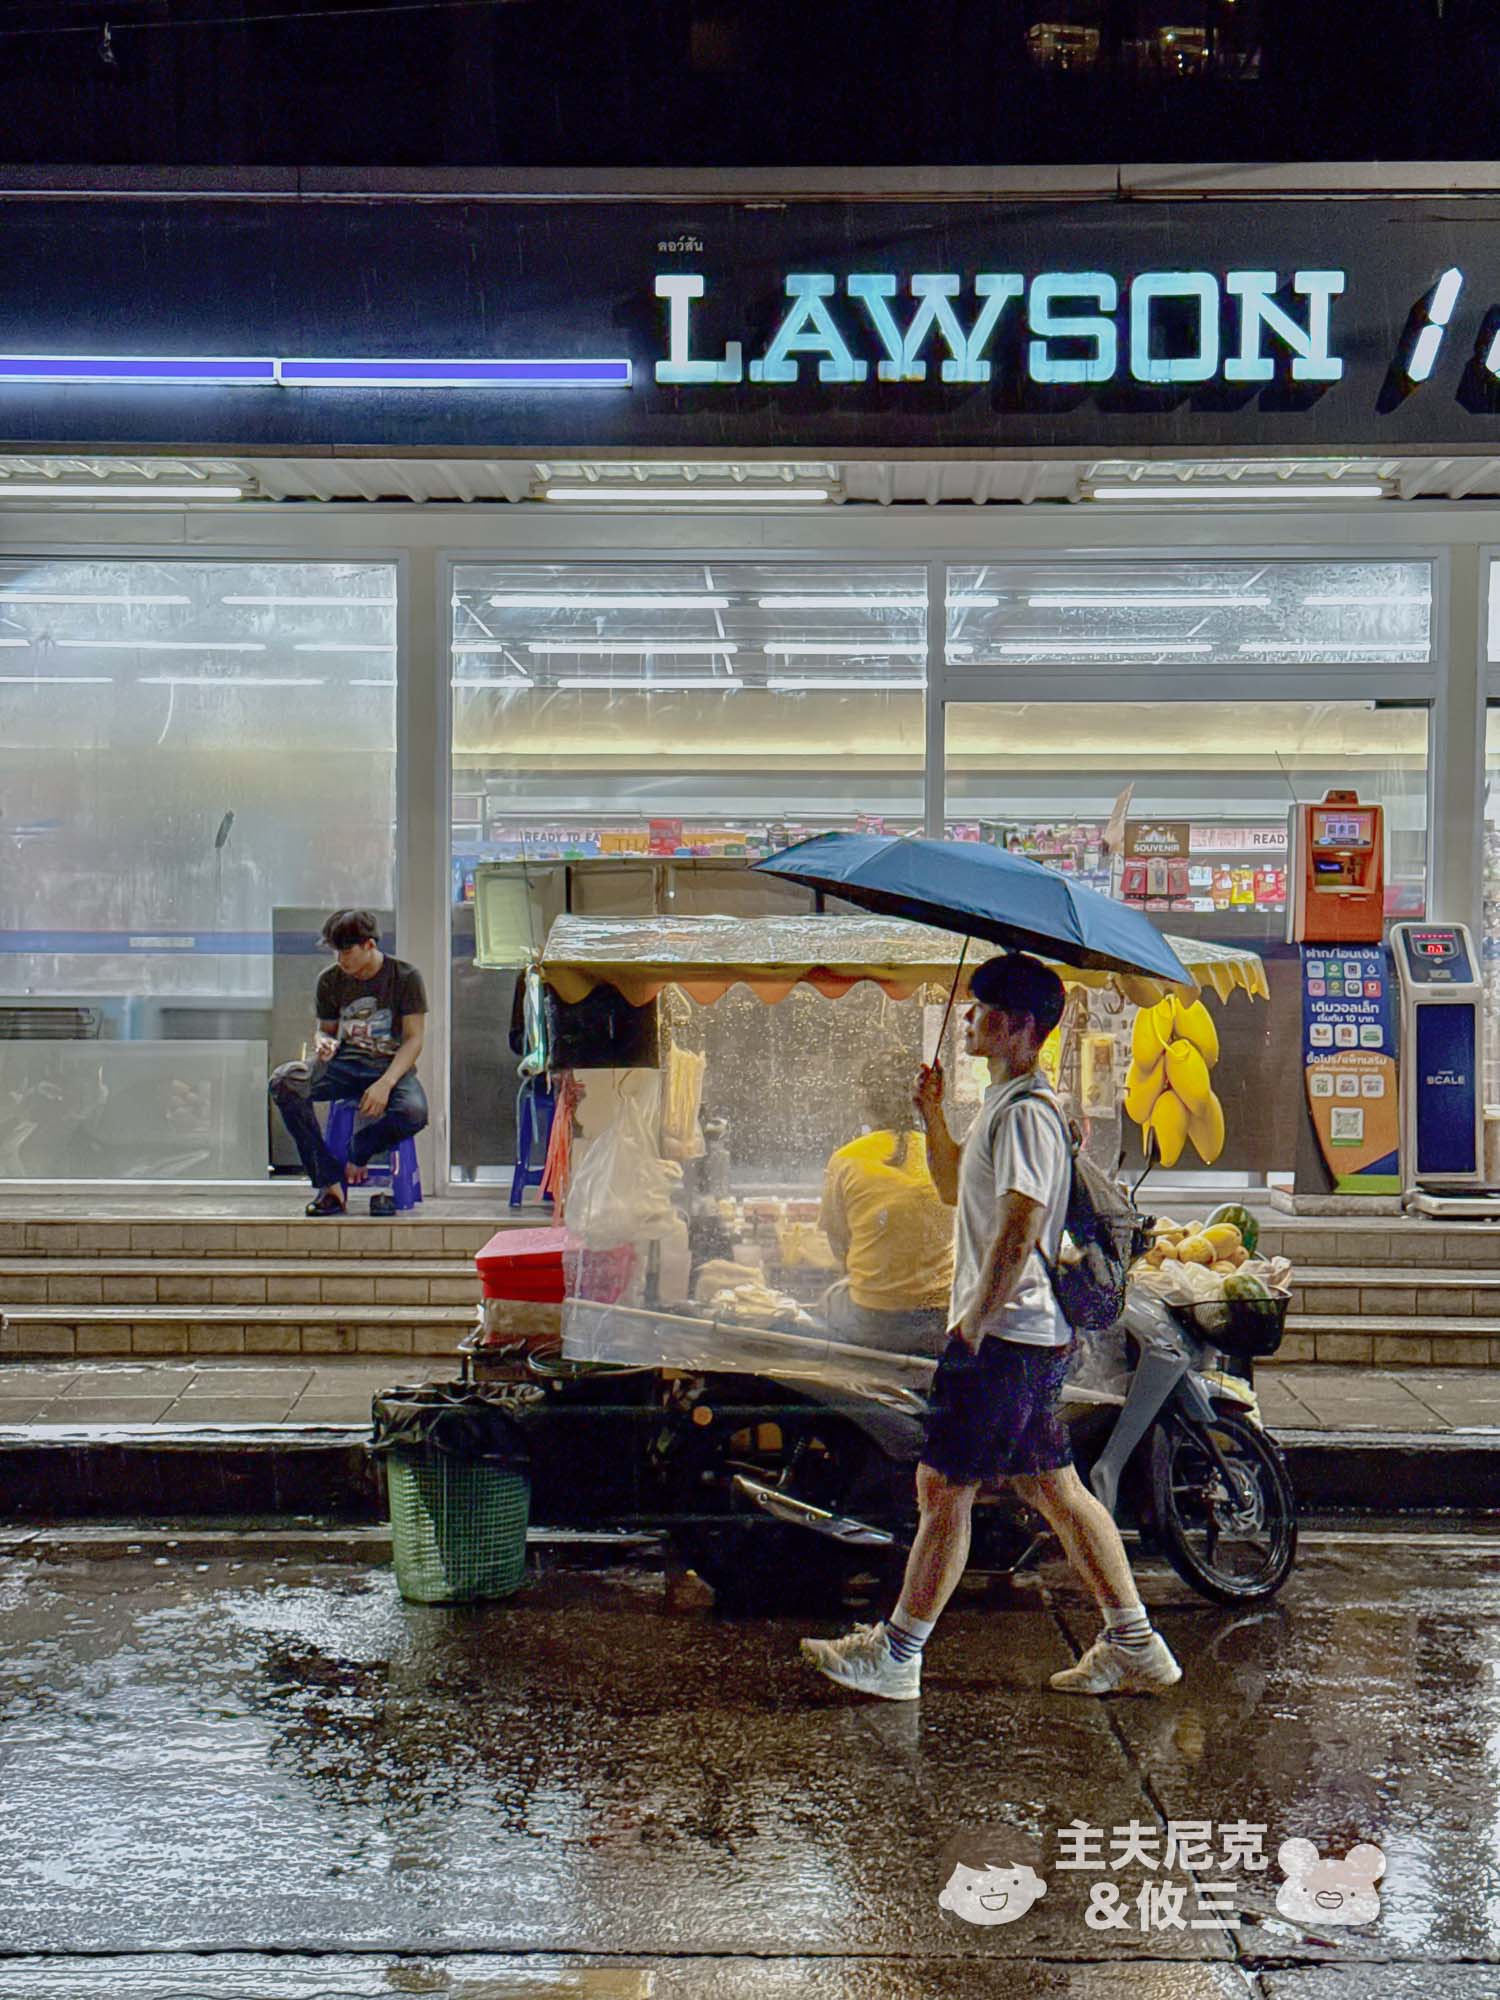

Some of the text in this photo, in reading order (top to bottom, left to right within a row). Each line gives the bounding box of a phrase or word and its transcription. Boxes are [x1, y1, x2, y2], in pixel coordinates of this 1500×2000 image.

[658, 235, 703, 252] ลอว์สัน
[654, 266, 1500, 384] LAWSON 1
[1133, 843, 1181, 853] SOUVENIR
[1345, 1014, 1356, 1023] 10
[1426, 1075, 1465, 1085] SCALE
